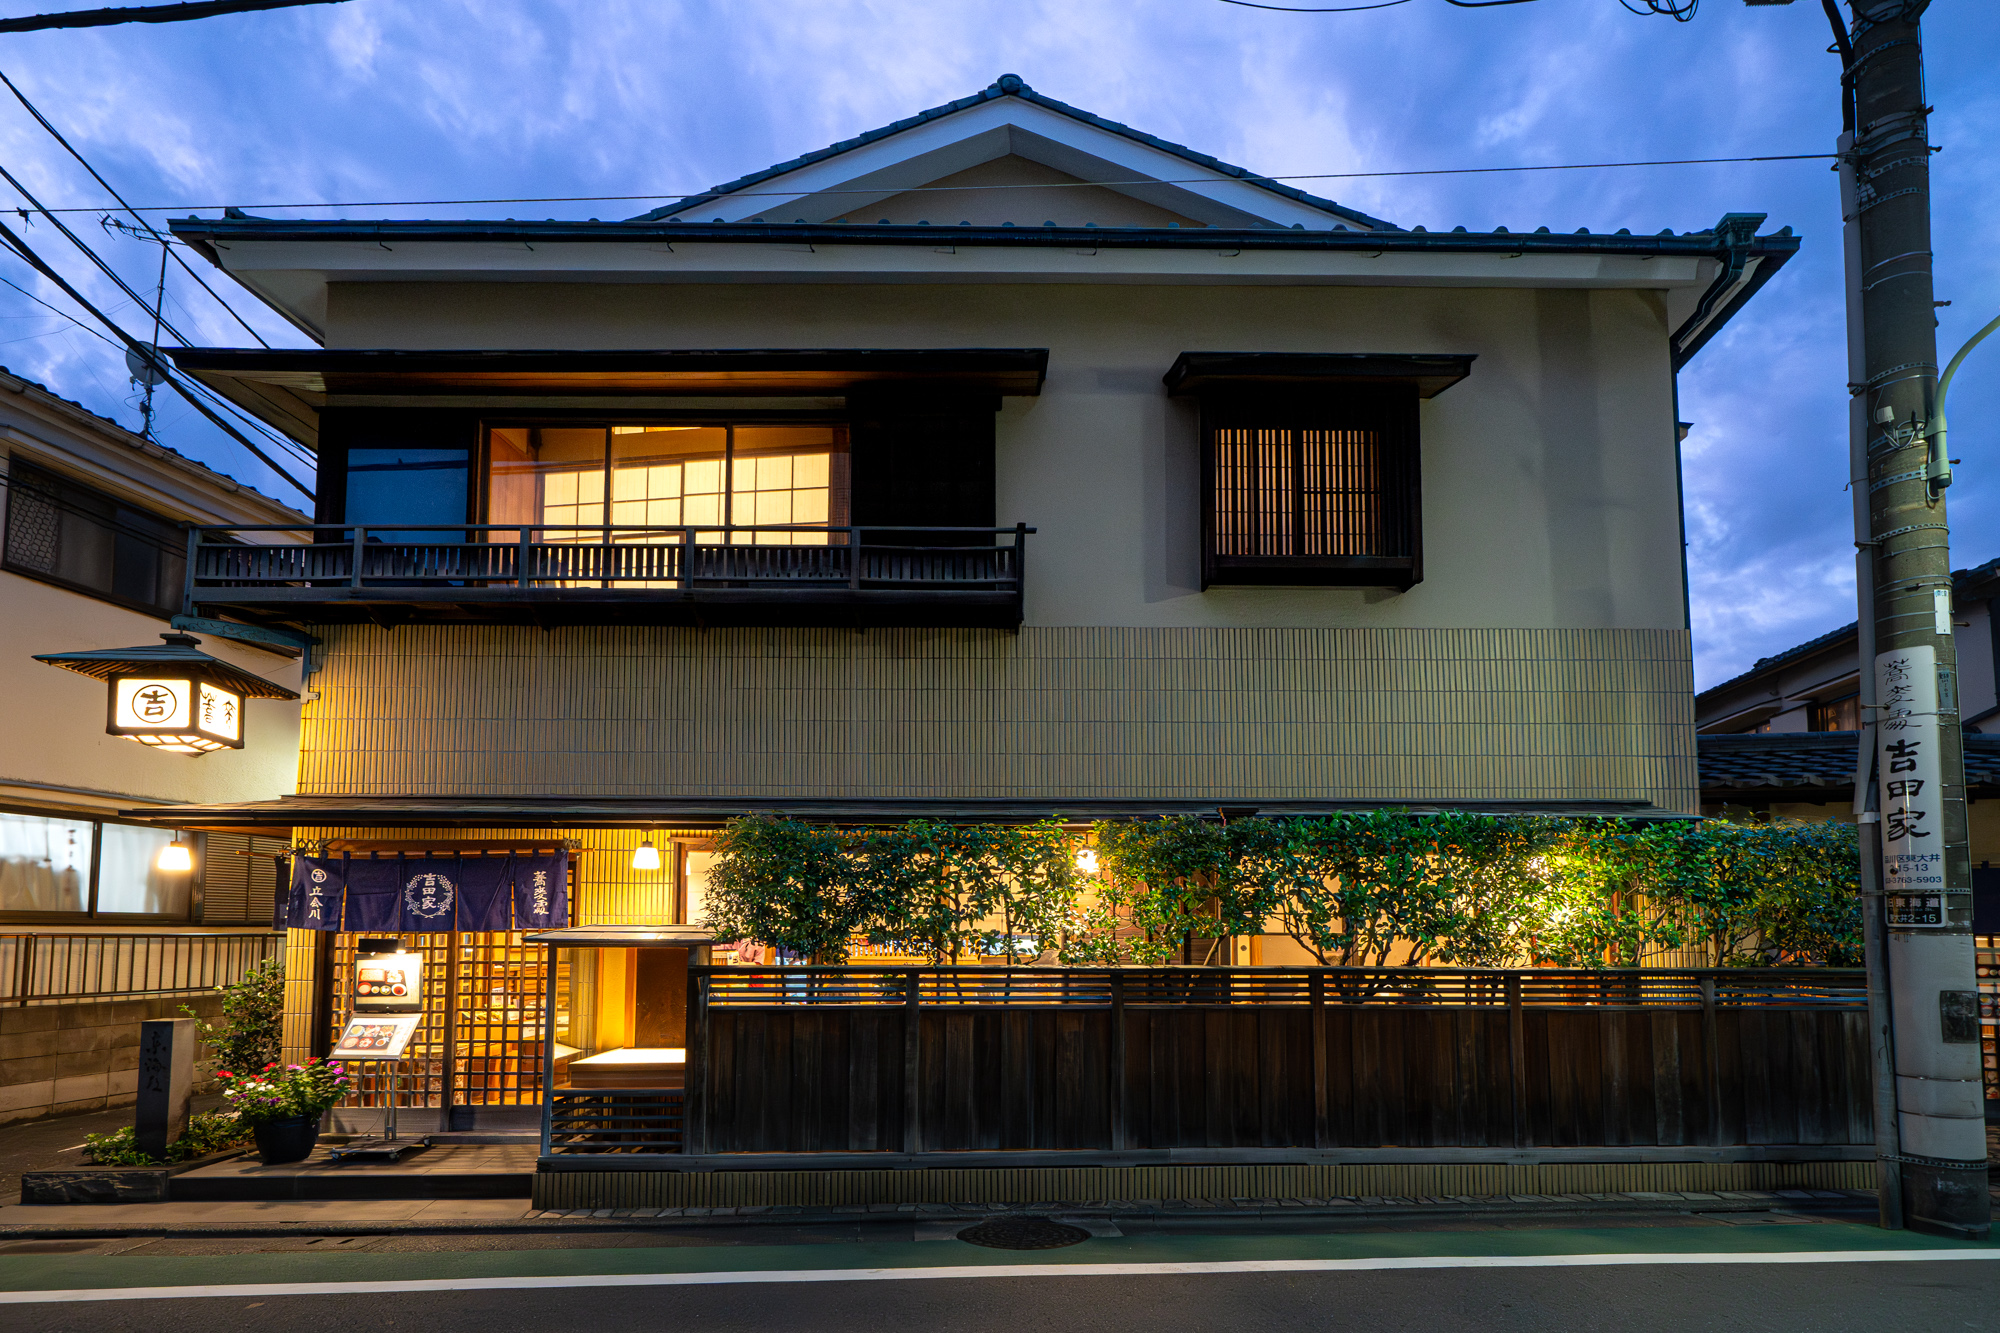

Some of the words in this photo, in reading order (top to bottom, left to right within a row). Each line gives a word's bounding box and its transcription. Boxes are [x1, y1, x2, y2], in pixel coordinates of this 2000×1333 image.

[138, 688, 170, 718] 吉
[1885, 739, 1931, 842] 吉田家
[308, 885, 324, 920] 立会川
[421, 872, 437, 910] 吉田家
